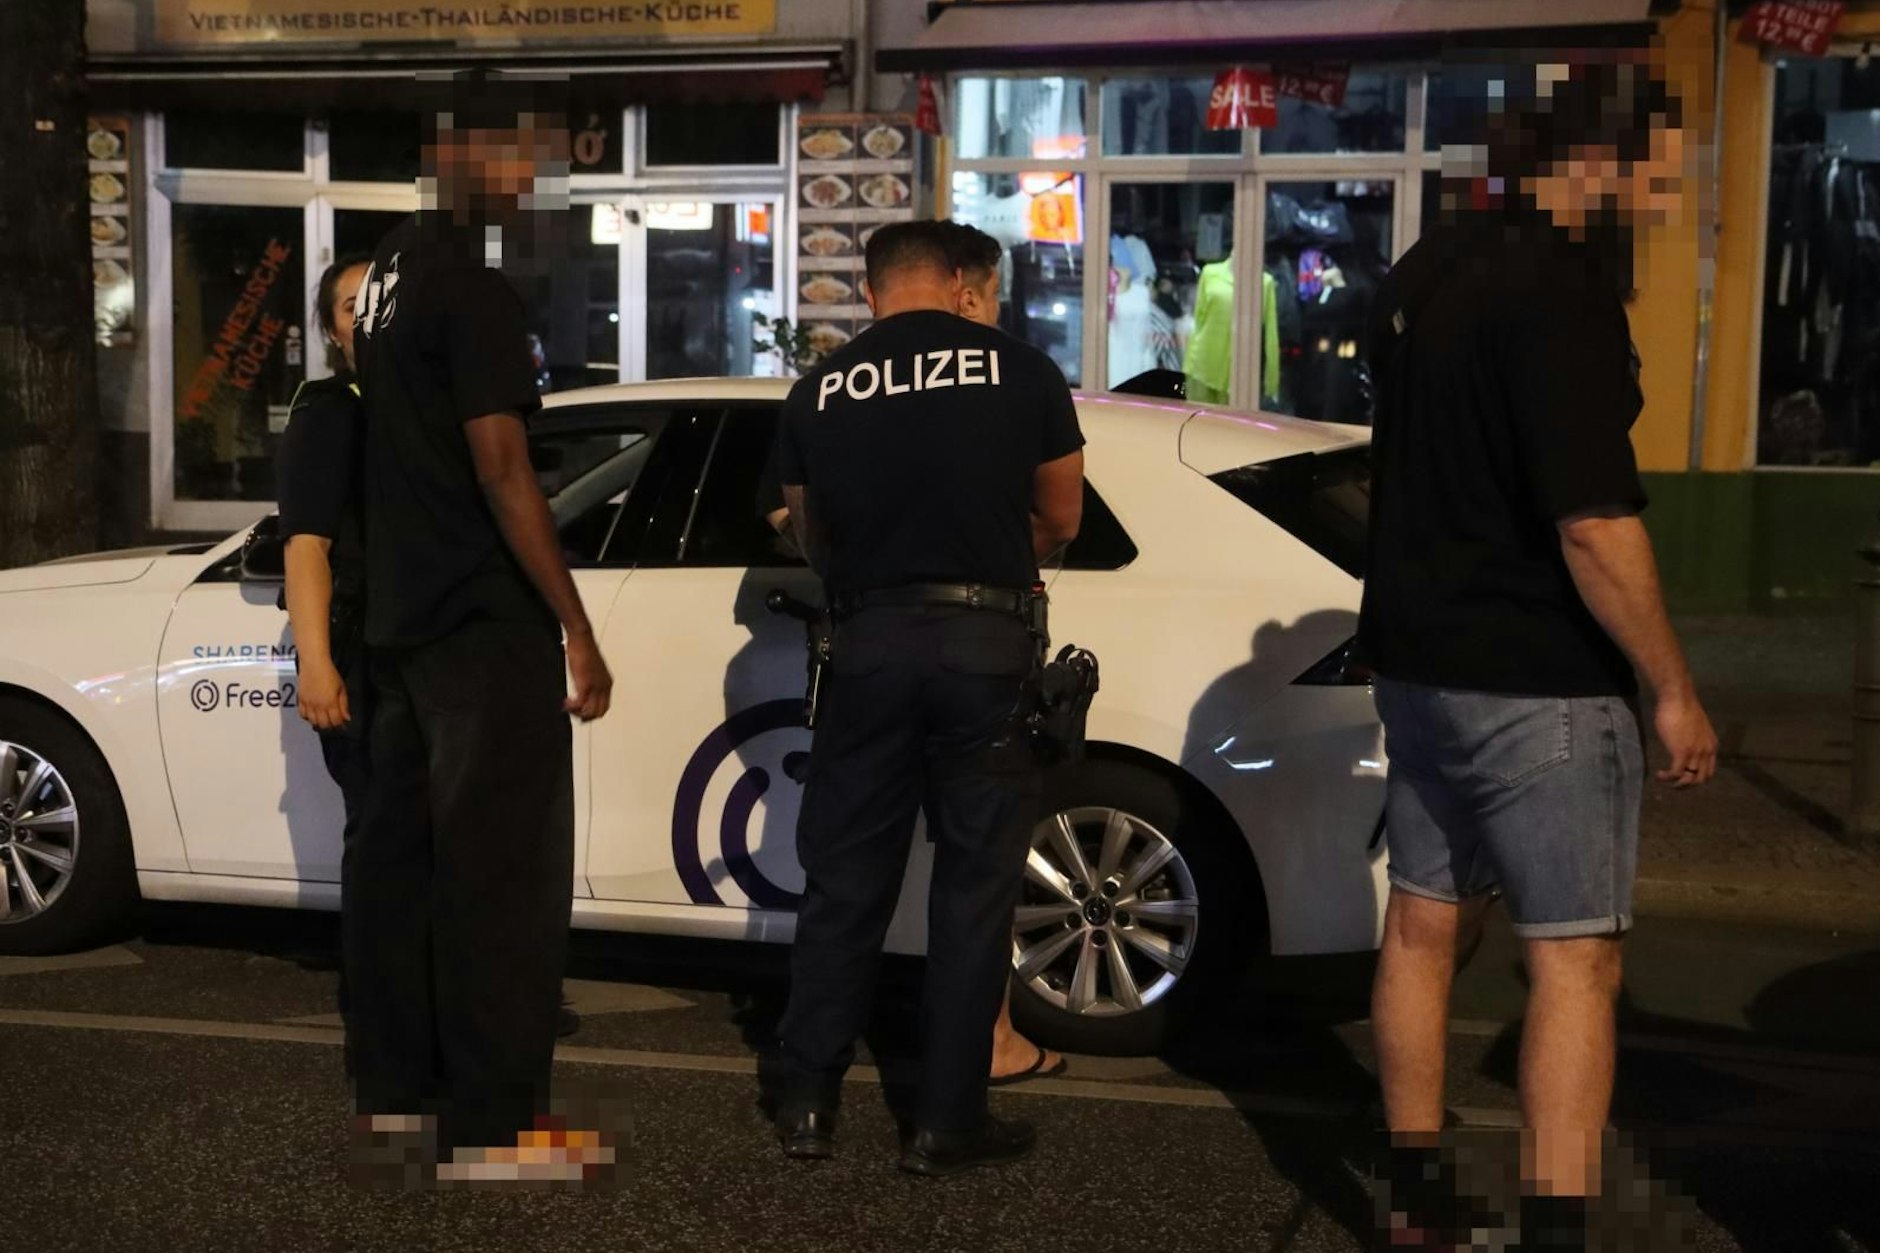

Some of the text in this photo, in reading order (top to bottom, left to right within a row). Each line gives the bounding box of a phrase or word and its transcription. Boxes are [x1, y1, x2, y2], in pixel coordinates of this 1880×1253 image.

[1210, 84, 1277, 109] SALE
[817, 349, 1001, 412] POLIZEI
[226, 682, 299, 708] Free2
